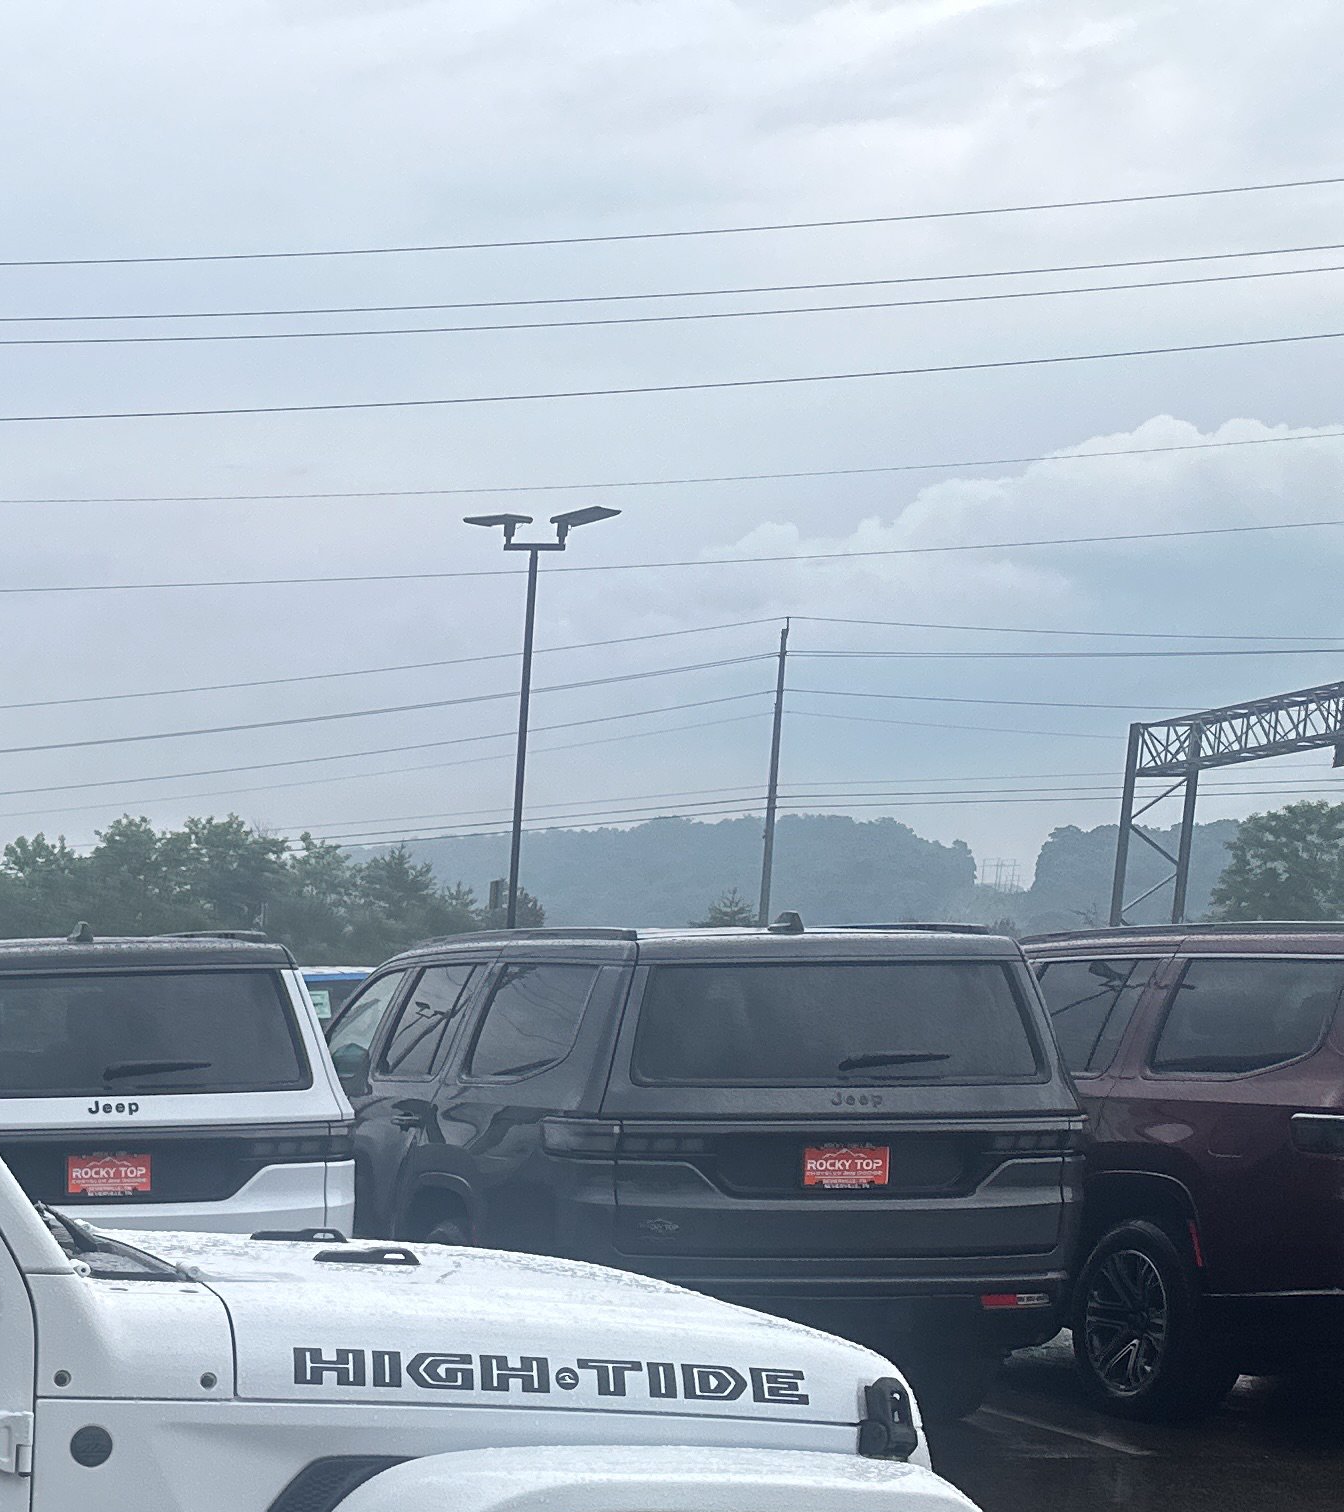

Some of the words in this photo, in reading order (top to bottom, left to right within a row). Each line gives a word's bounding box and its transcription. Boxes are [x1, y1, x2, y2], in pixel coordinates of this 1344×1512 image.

[832, 1090, 883, 1108] Jeep
[88, 1101, 139, 1115] Jeep
[806, 1159, 852, 1170] ROCKY
[855, 1159, 883, 1170] TOP
[72, 1167, 116, 1179] ROCKY
[119, 1166, 146, 1178] TOP
[293, 1347, 551, 1394] HIGH
[576, 1358, 810, 1405] TIDE
